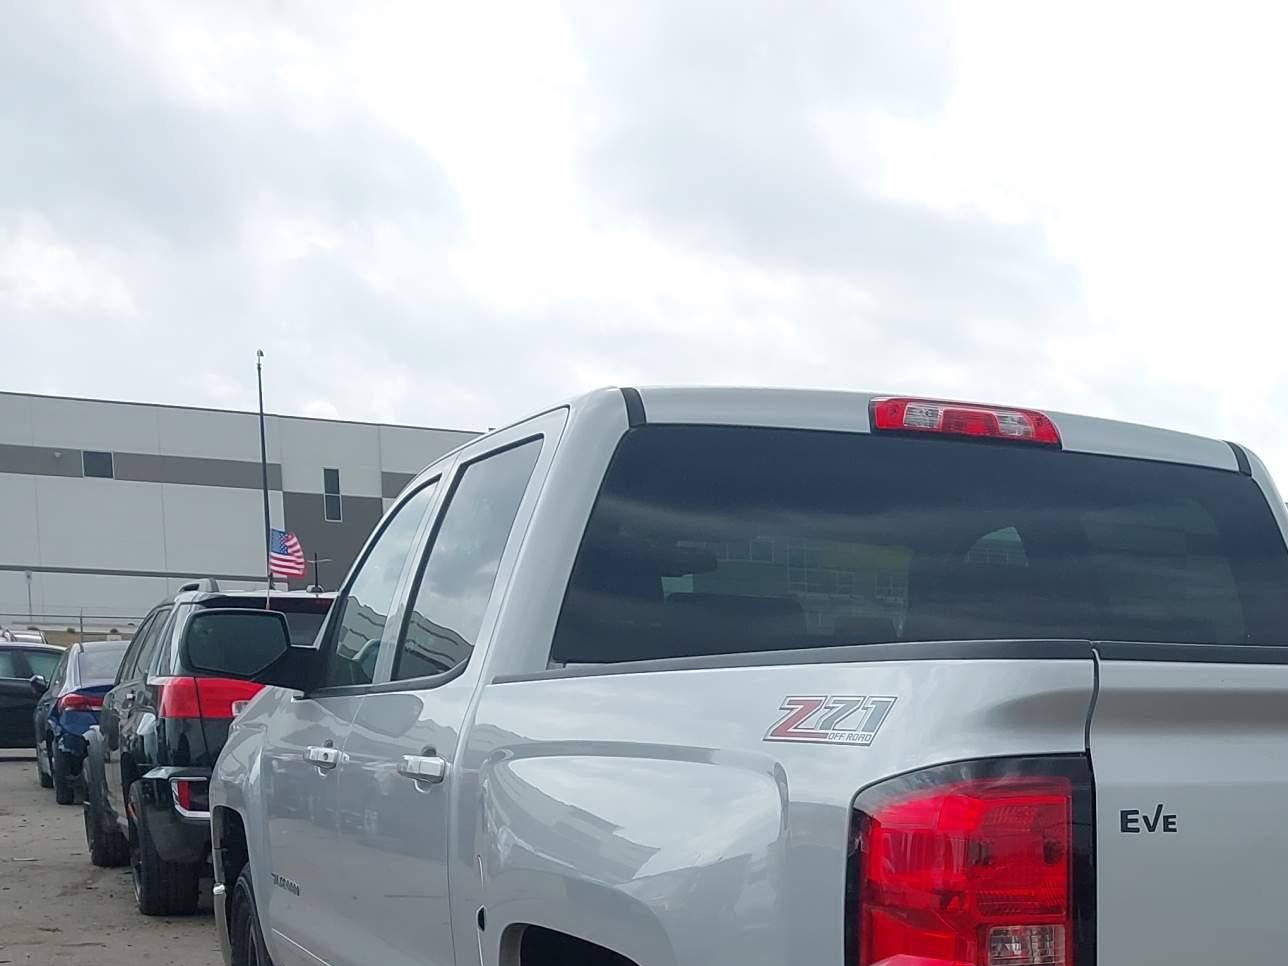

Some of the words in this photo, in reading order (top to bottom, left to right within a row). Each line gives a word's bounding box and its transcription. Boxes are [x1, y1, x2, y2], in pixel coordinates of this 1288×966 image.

[763, 695, 898, 744] Z71
[828, 732, 846, 741] OFF
[847, 732, 873, 742] ROAD
